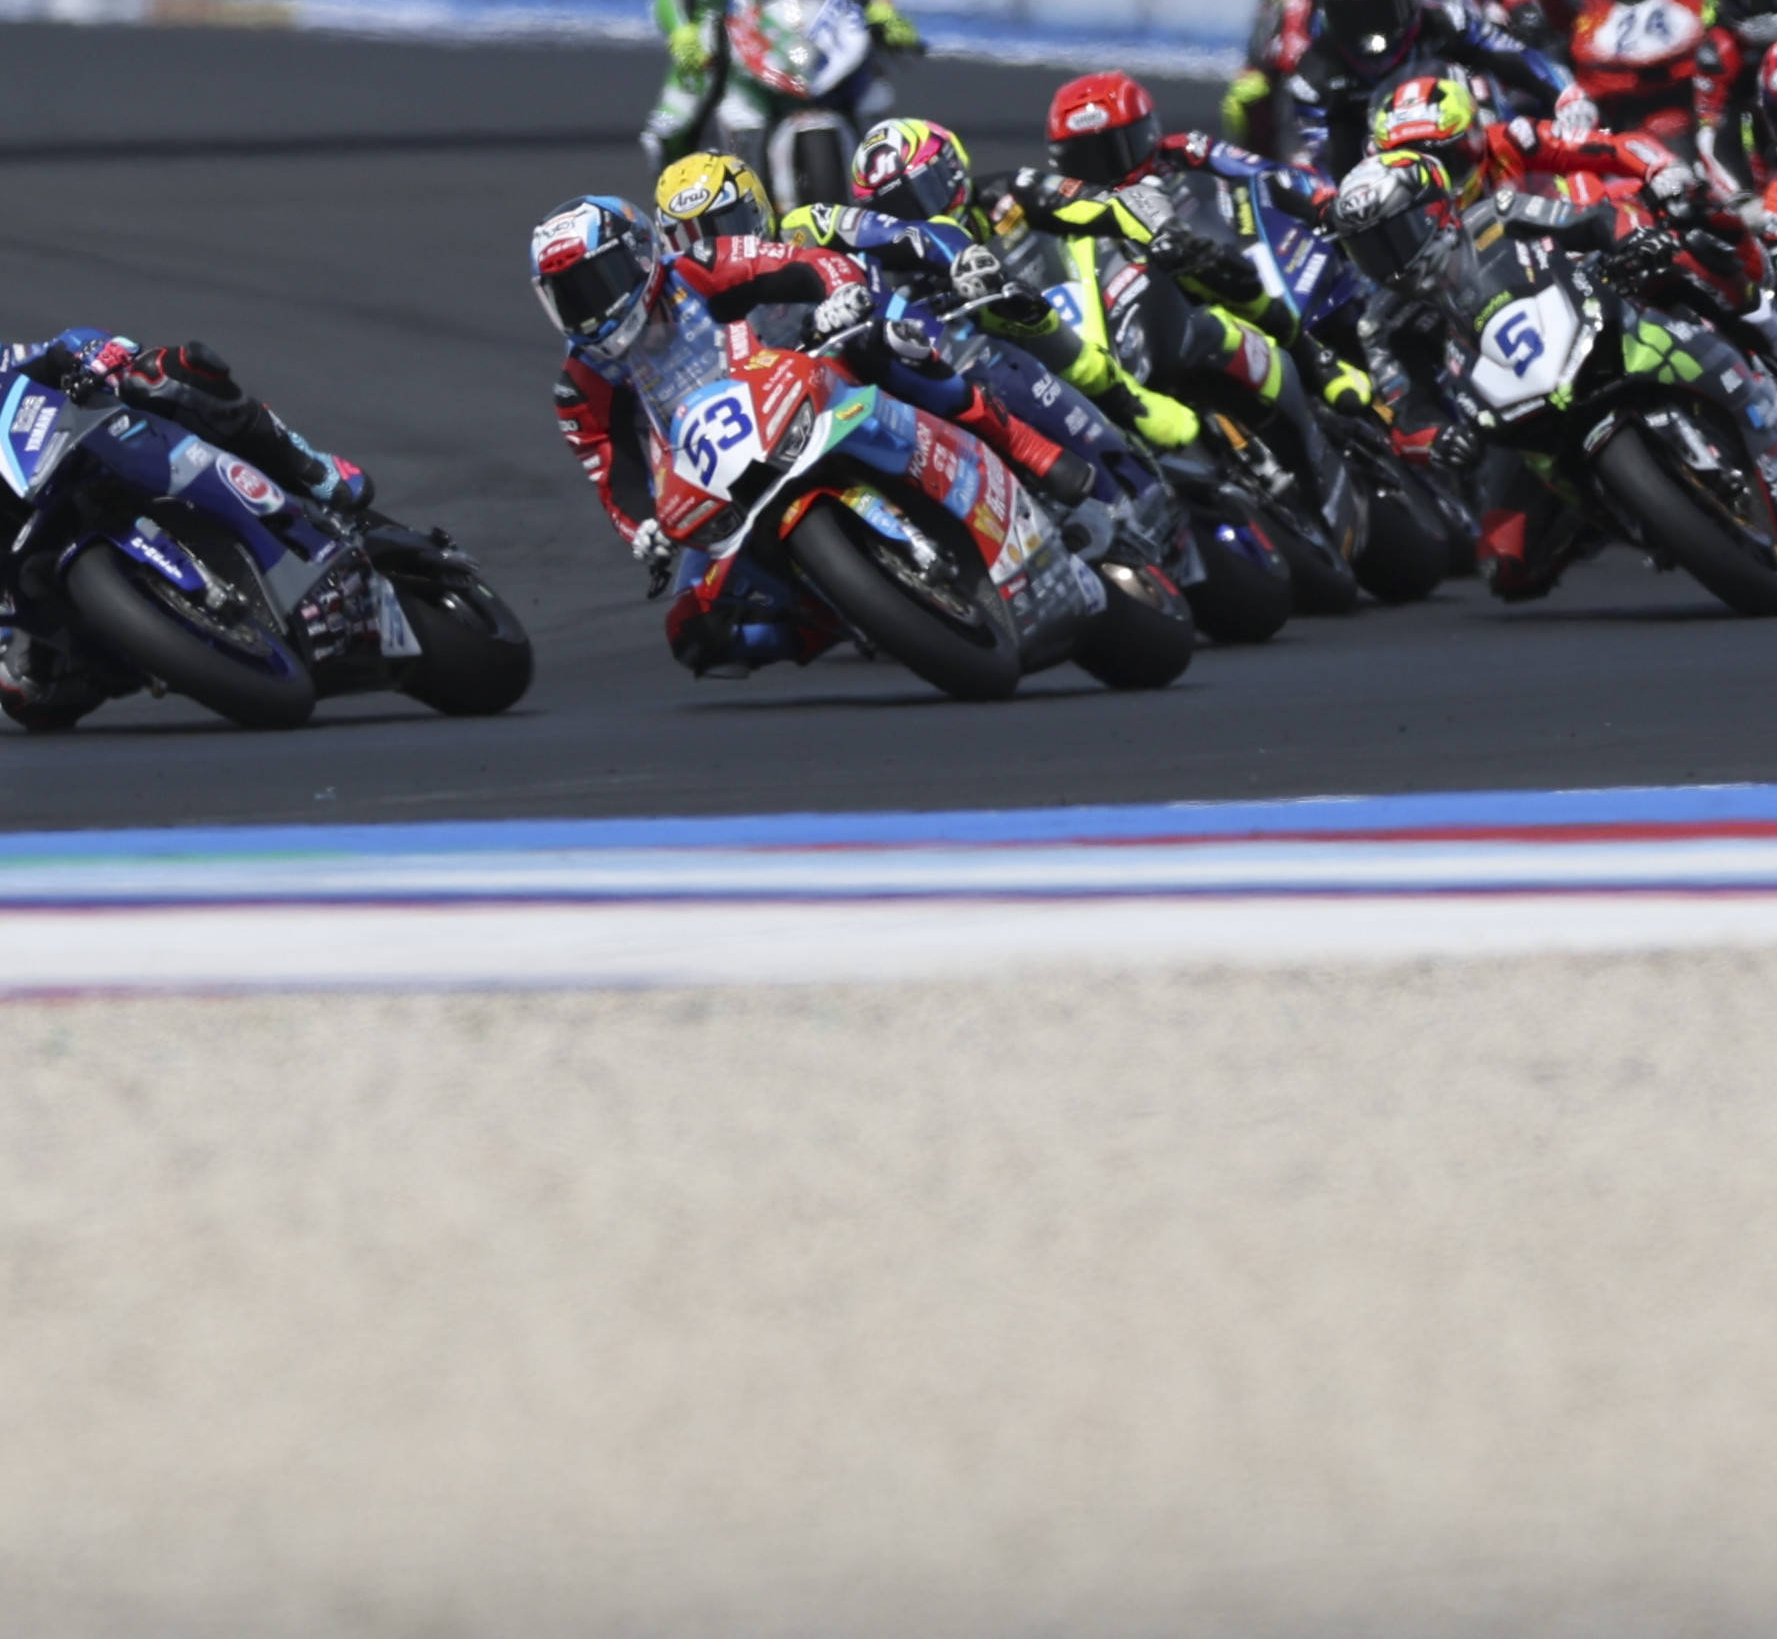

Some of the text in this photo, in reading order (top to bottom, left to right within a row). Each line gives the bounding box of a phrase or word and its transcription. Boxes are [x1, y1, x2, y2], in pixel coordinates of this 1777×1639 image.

[673, 189, 709, 211] Arai
[1494, 312, 1545, 378] 5
[683, 396, 754, 487] 53
[907, 421, 933, 479] HONOR
